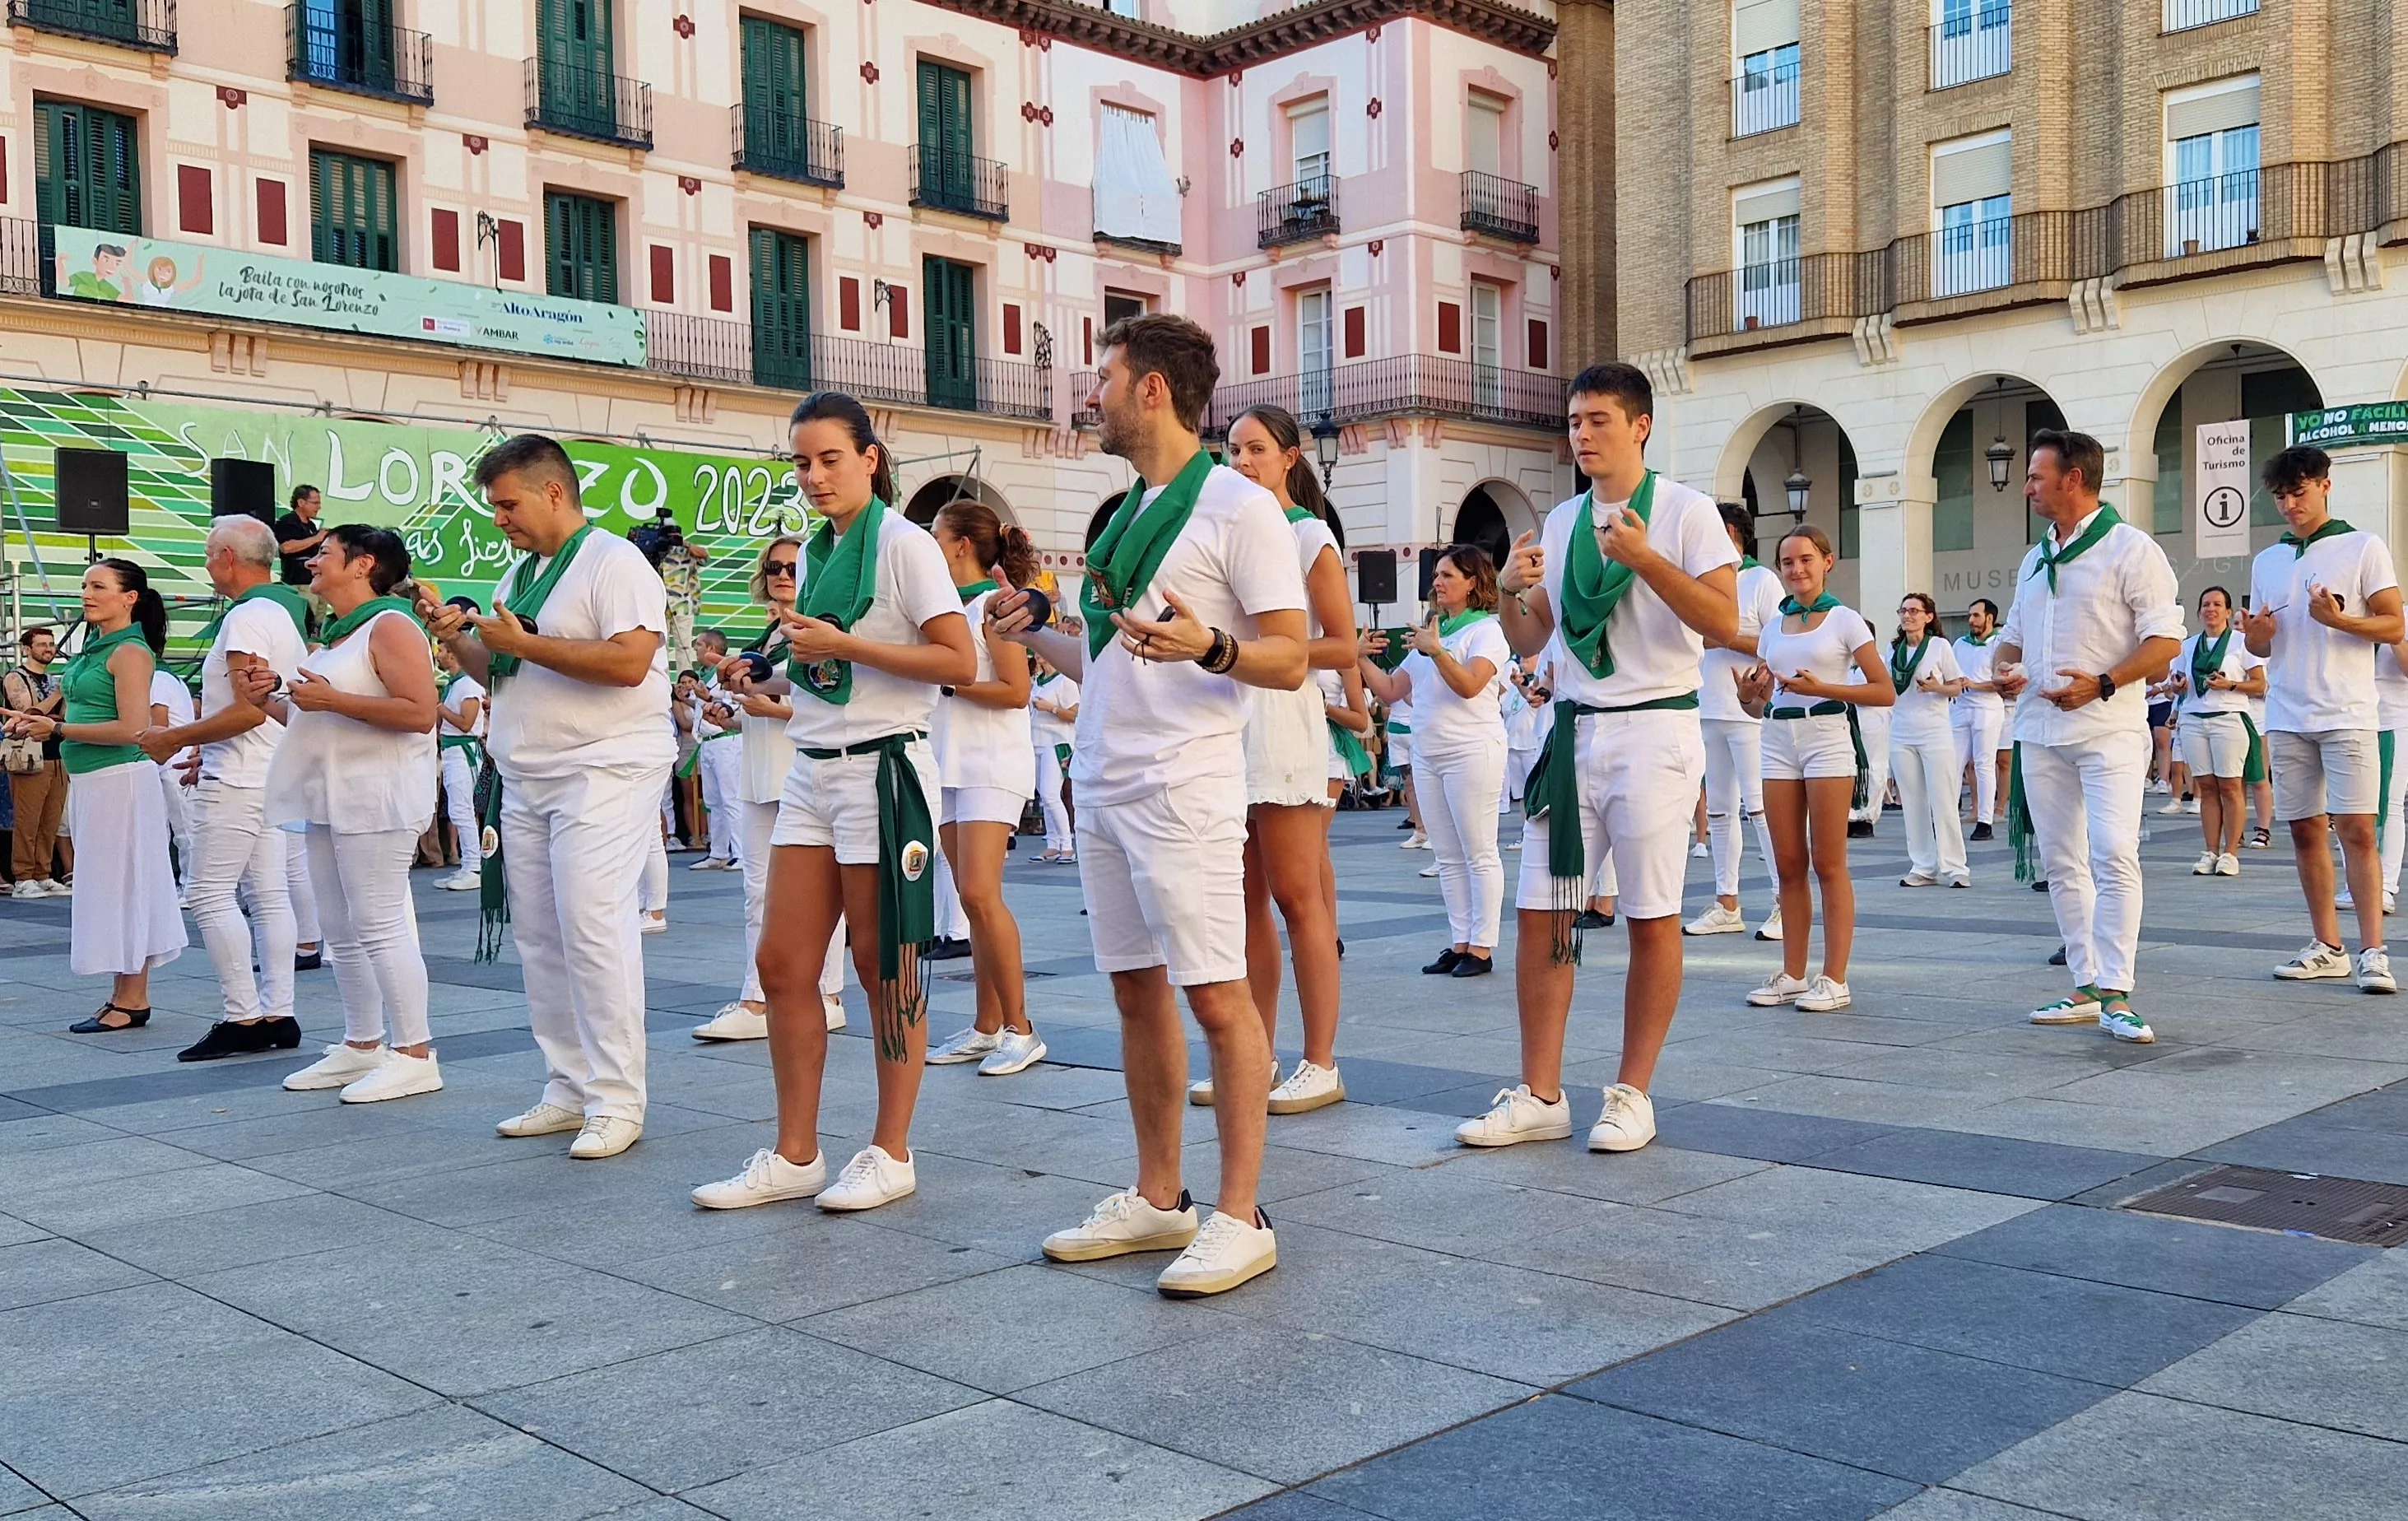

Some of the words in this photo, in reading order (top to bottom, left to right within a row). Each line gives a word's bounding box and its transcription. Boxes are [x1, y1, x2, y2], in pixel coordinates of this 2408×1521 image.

[239, 266, 282, 287] Baila
[287, 277, 309, 289] con
[314, 281, 365, 300] nosotros
[219, 281, 234, 297] la
[234, 284, 264, 303] jota
[268, 287, 287, 305] de
[291, 289, 318, 307] San
[322, 294, 379, 316] Lorenzo
[482, 327, 519, 340] AMBAR
[2298, 414, 2321, 430] YO
[2323, 410, 2347, 426] NO
[2350, 403, 2408, 421] FACILI
[2207, 435, 2245, 446] Oficina
[2298, 423, 2355, 444] ALCOHOL
[2358, 423, 2367, 434] A
[2368, 421, 2408, 433] MENO
[2232, 446, 2245, 456] de
[2202, 458, 2245, 471] Turismo
[179, 421, 294, 489] SAN
[327, 429, 667, 520] LORZO
[694, 463, 809, 537] 2023
[405, 528, 444, 565] as
[1944, 568, 2019, 592] MUSE
